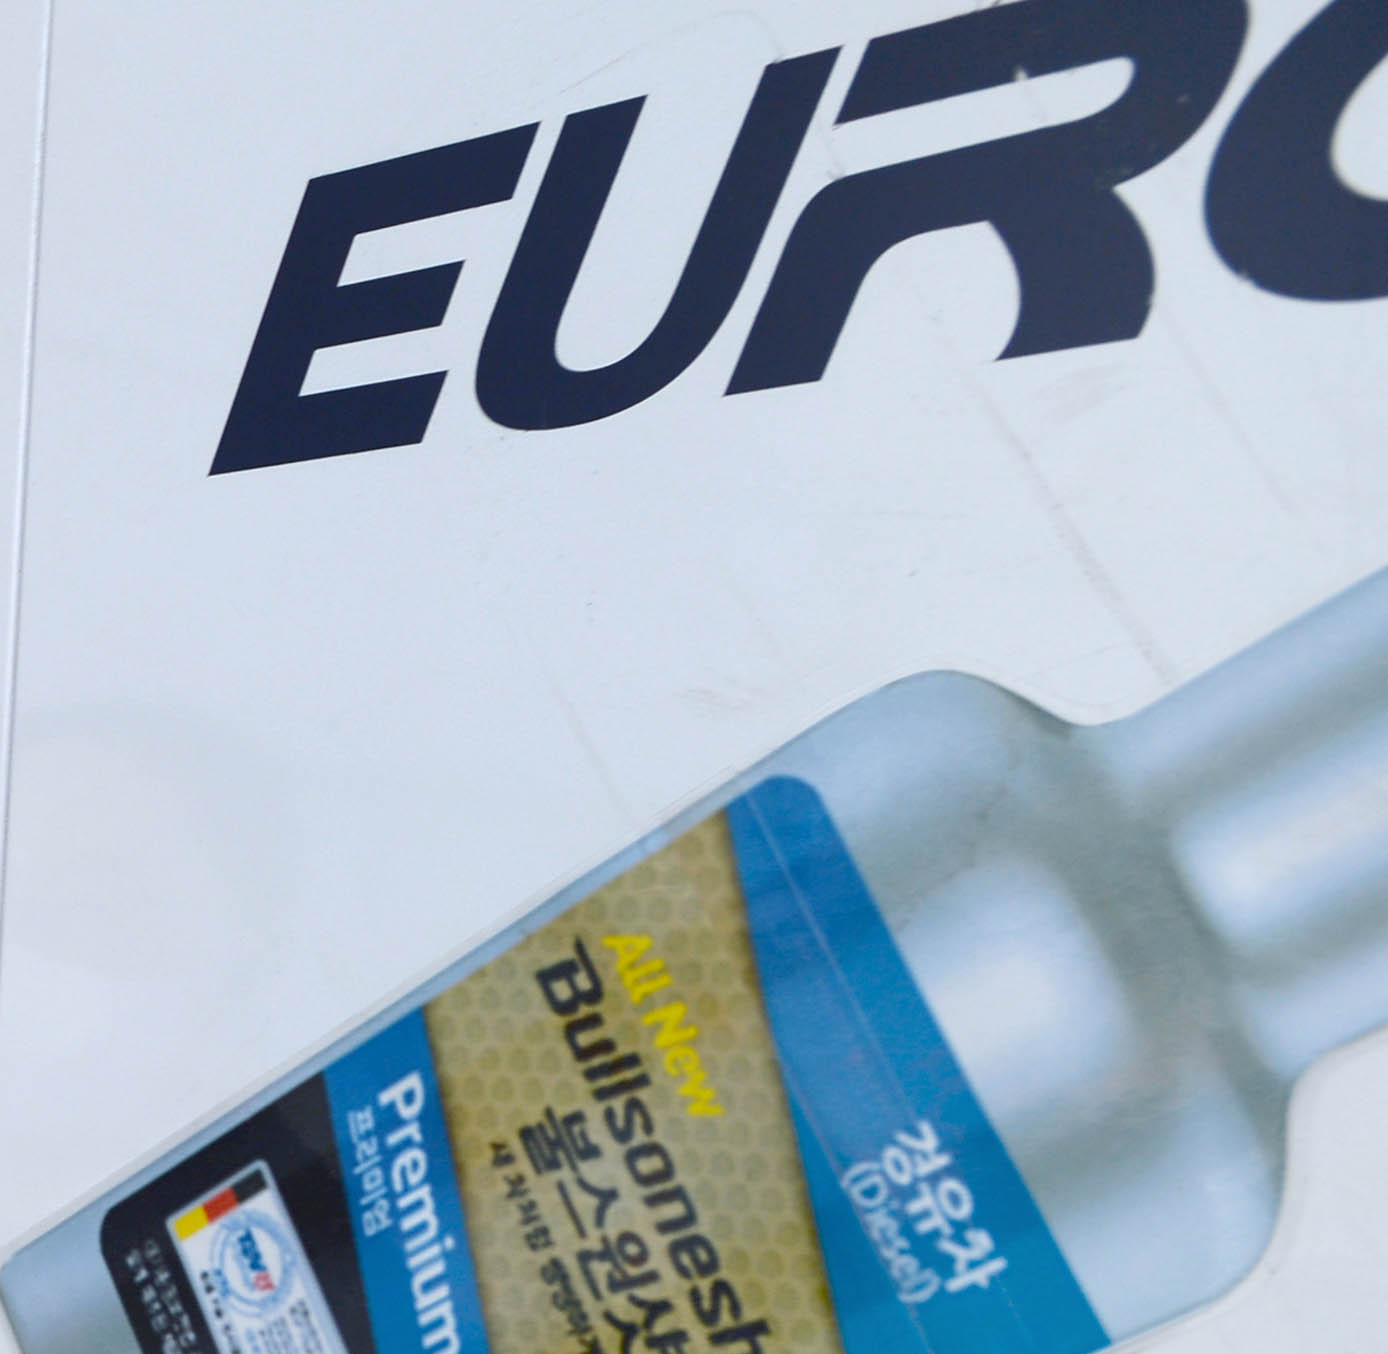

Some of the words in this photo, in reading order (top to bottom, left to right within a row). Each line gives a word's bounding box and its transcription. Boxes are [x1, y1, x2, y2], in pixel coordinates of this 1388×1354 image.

[601, 933, 672, 1003] All
[643, 1001, 722, 1117] New
[346, 1107, 394, 1238] 프리미엄
[840, 1159, 940, 1305] (Diesel)
[877, 1119, 1009, 1295] 경유차
